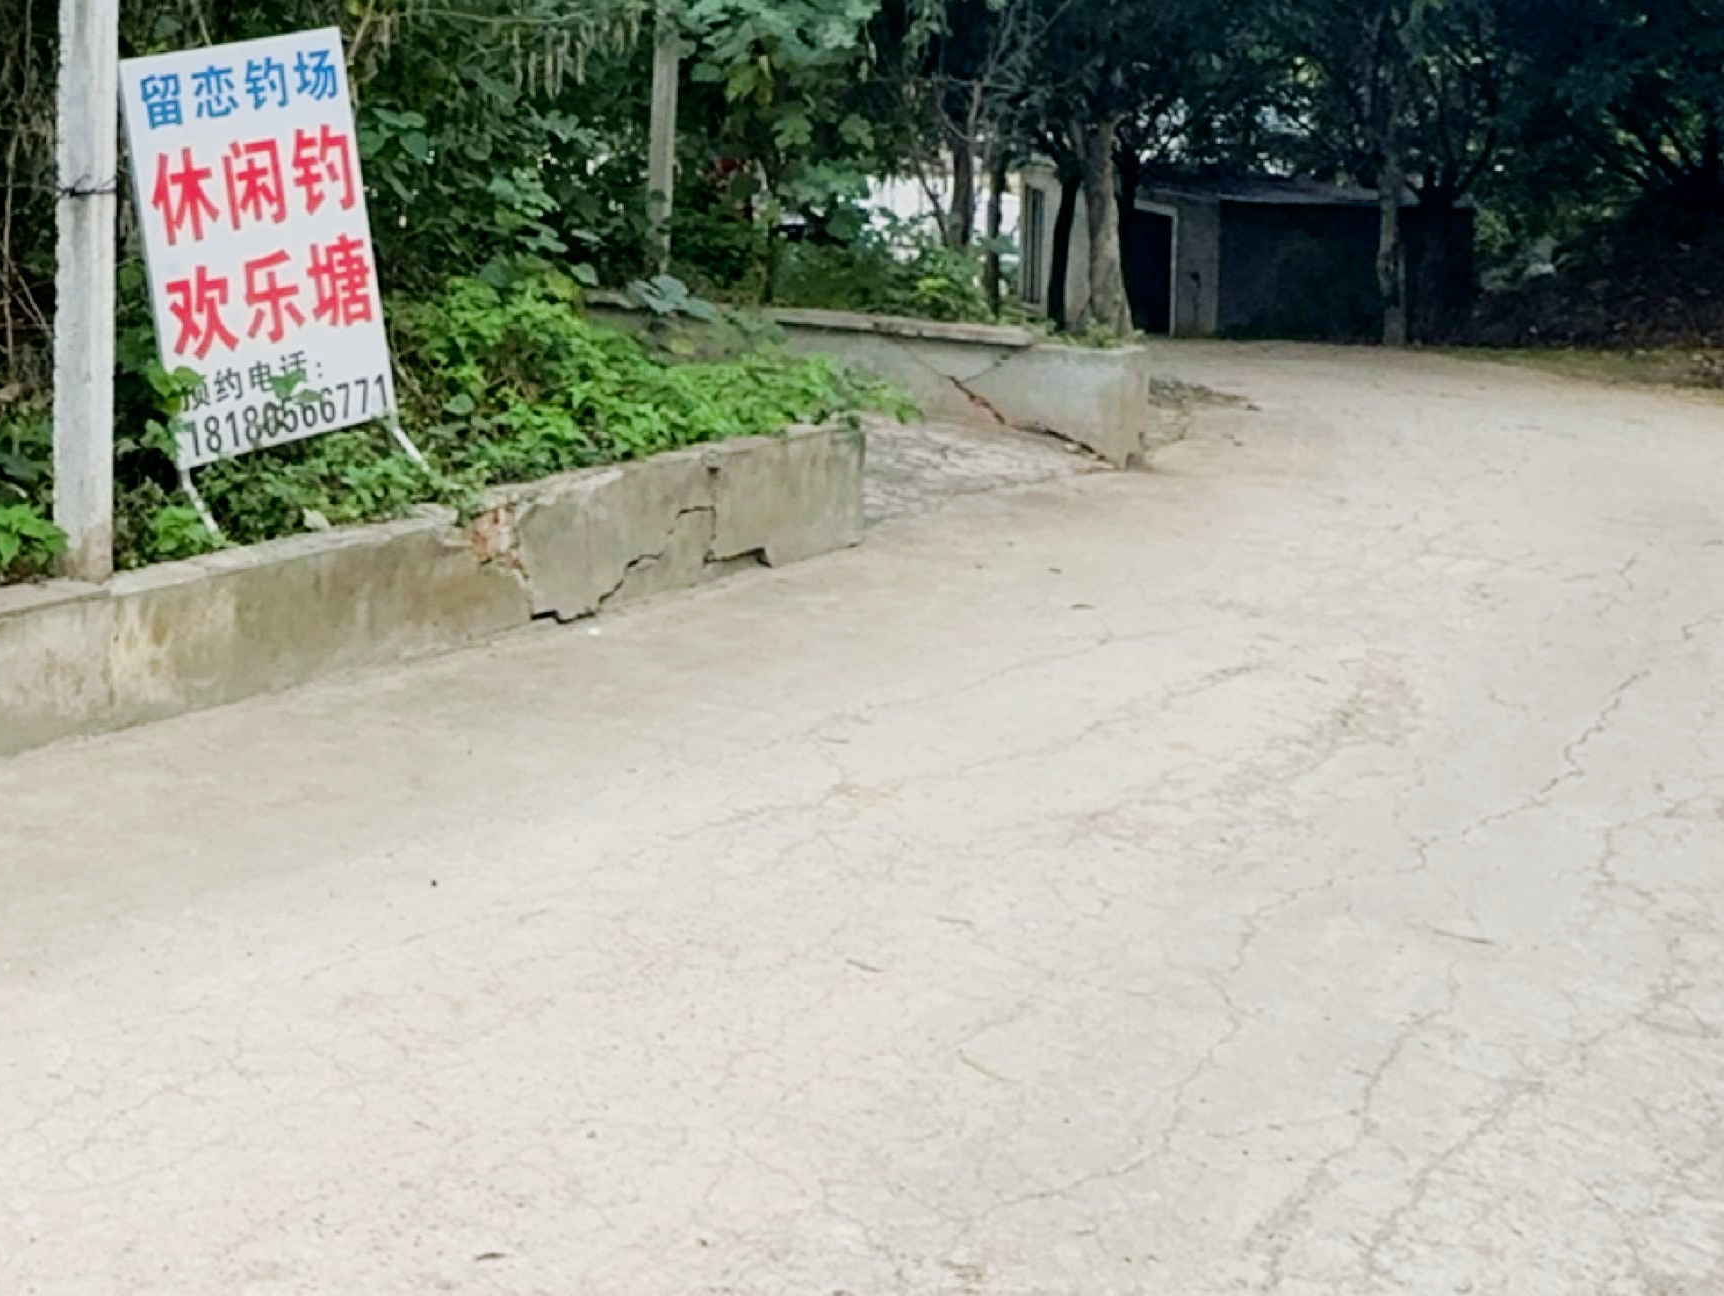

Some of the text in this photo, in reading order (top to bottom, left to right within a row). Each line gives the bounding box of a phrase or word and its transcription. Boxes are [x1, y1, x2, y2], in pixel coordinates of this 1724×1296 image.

[139, 48, 338, 130] 留恋钓场
[151, 123, 357, 246] 休闲钓
[165, 233, 374, 361] 欢乐塘
